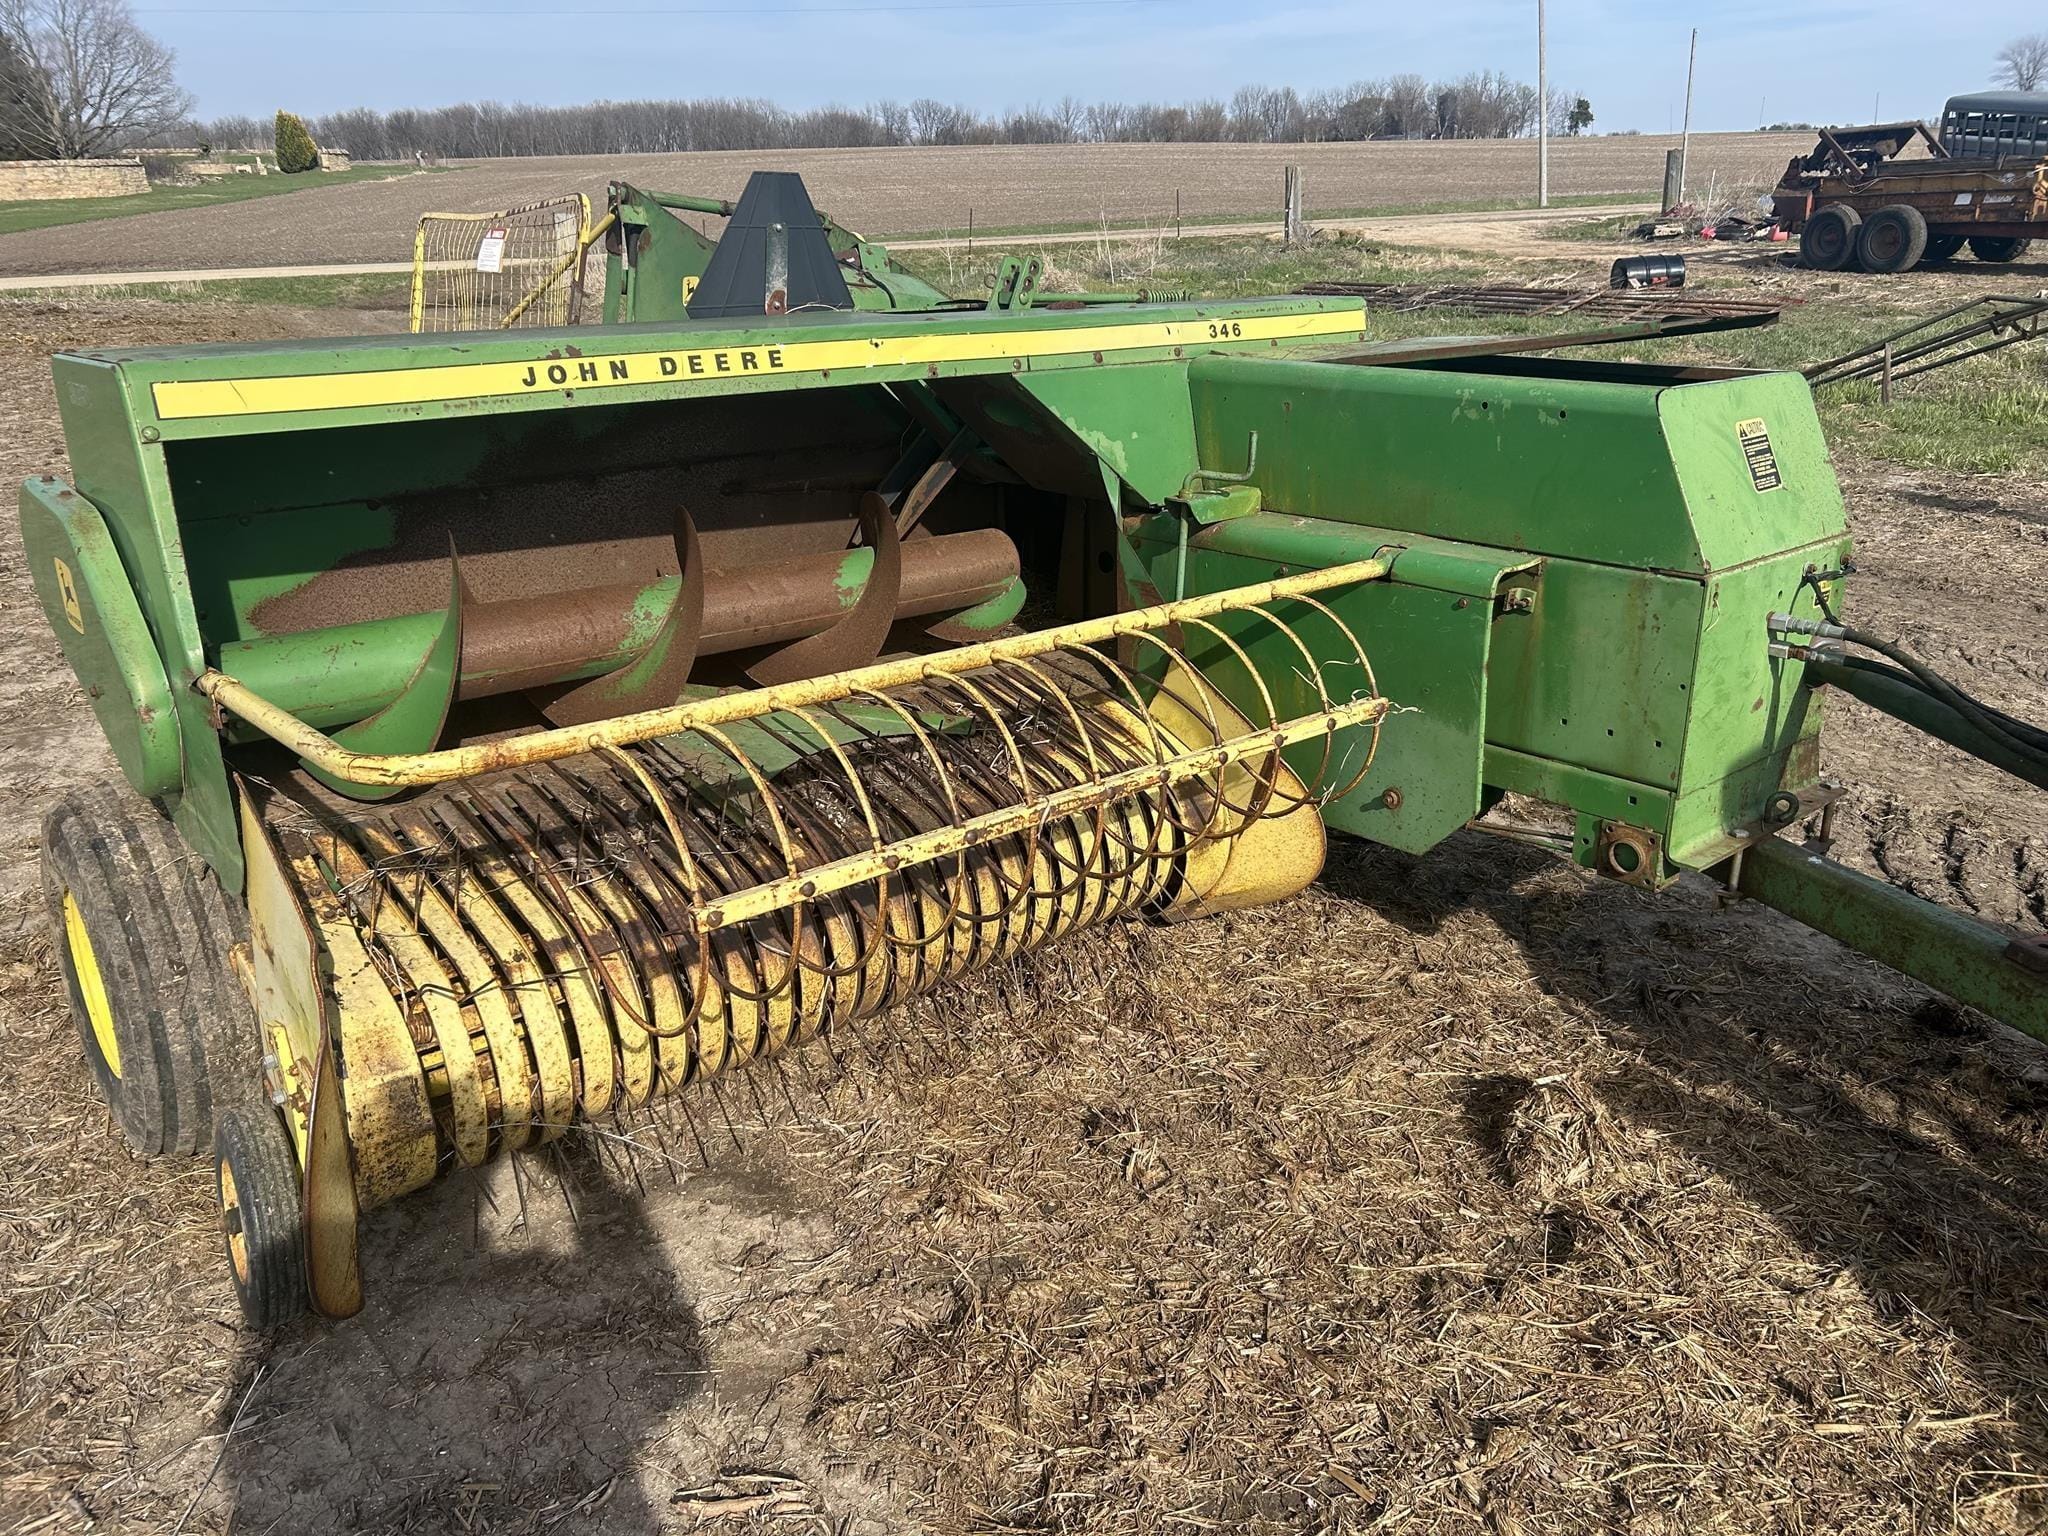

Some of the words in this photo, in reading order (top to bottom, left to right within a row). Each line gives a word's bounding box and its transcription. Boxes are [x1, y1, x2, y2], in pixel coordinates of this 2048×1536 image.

[1209, 323, 1241, 338] 346
[522, 359, 629, 387] JOHN
[659, 349, 784, 377] DEERE
